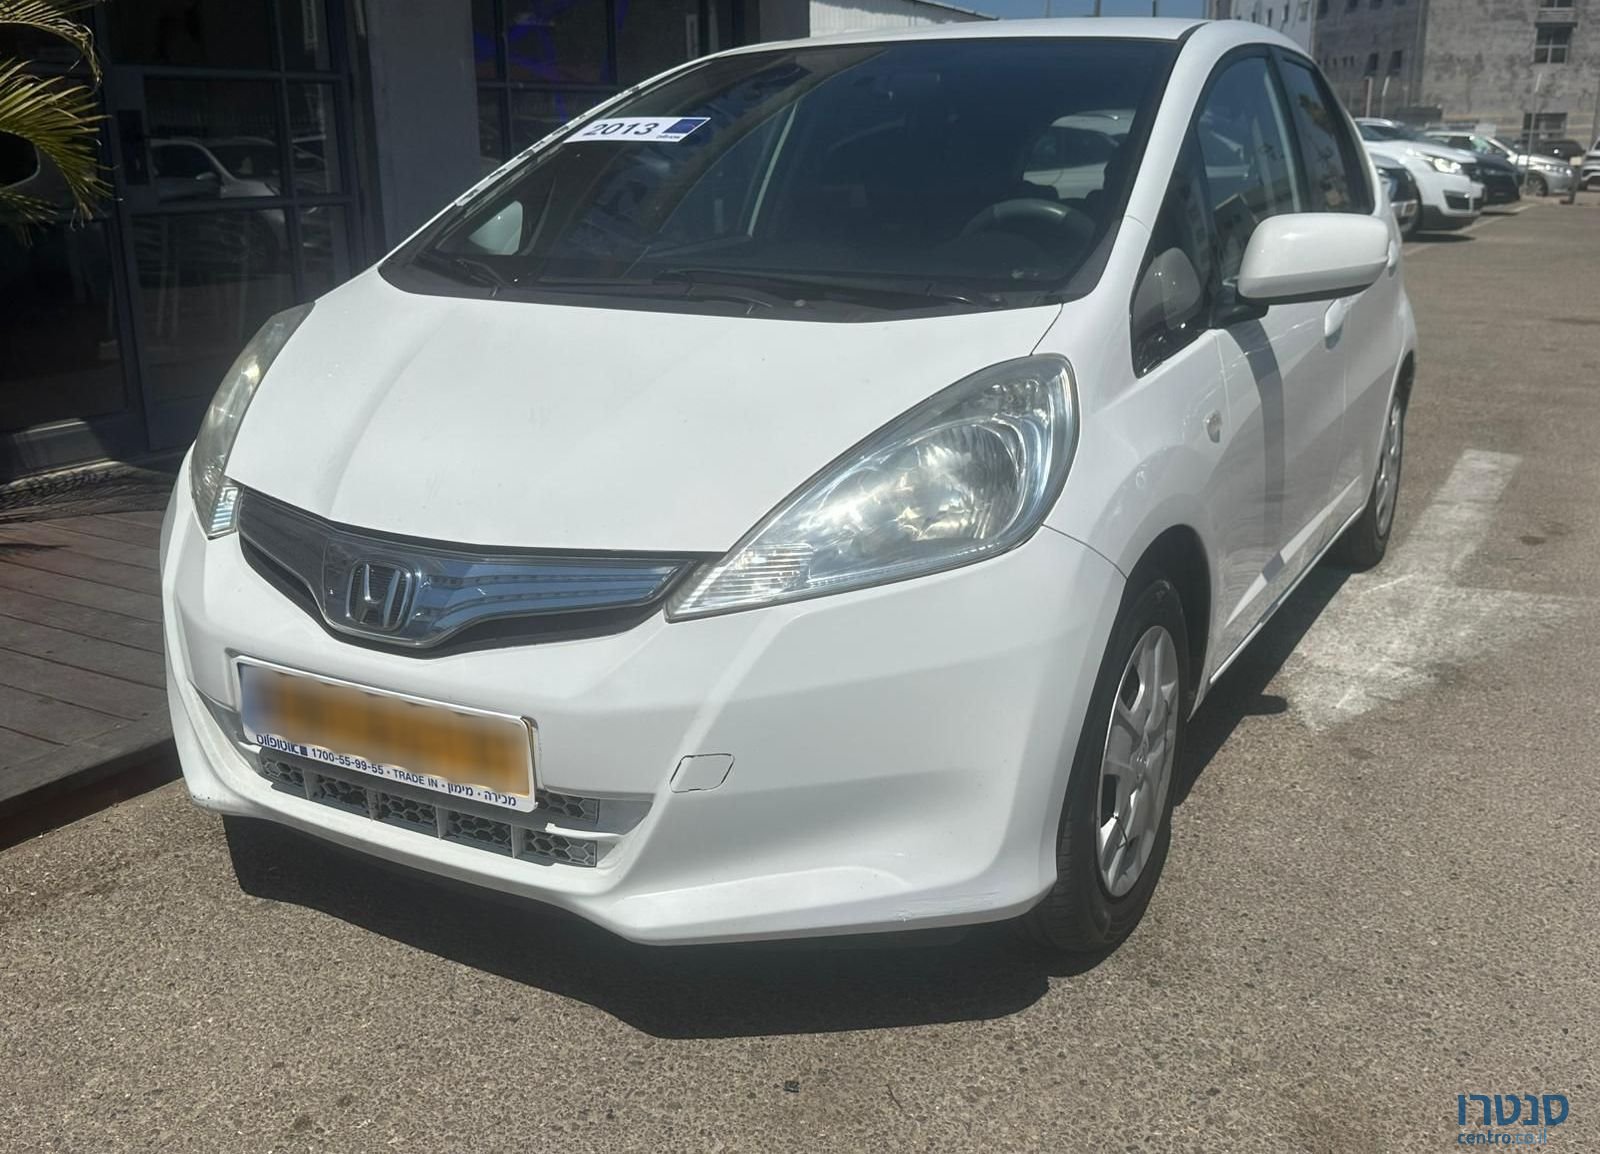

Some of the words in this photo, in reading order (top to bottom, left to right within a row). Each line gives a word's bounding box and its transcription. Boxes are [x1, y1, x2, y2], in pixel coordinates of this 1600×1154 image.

[583, 122, 659, 136] 2013
[311, 748, 384, 775] 1700-55-99-55
[392, 769, 425, 785] TRADE
[427, 777, 438, 788] IN
[447, 782, 474, 797] מימון
[484, 791, 517, 806] מכירה
